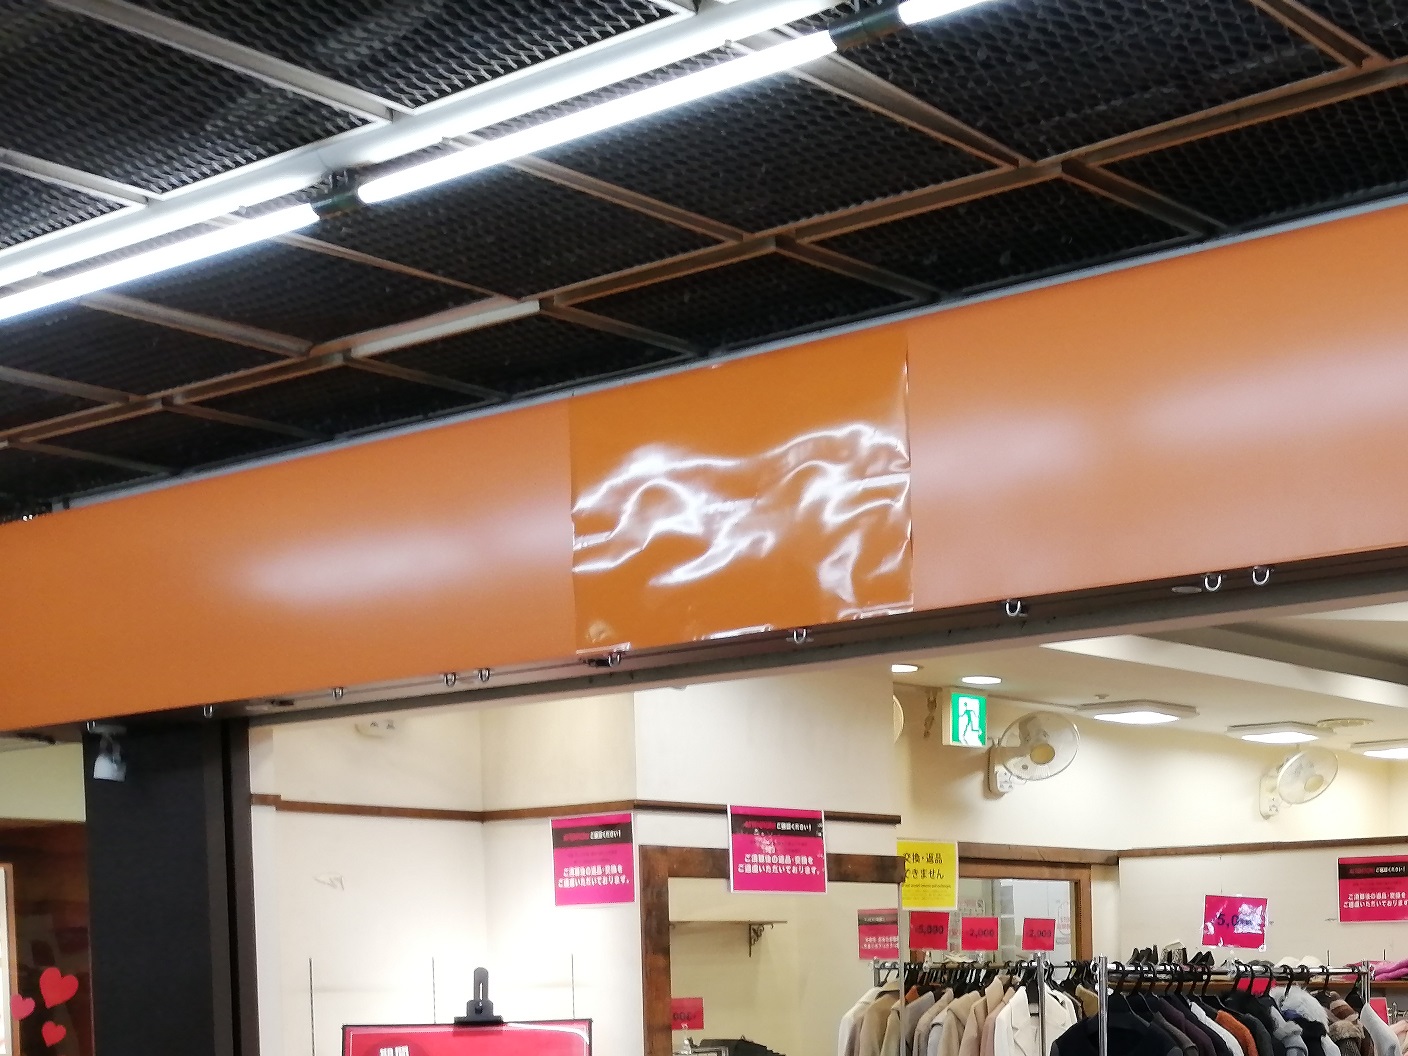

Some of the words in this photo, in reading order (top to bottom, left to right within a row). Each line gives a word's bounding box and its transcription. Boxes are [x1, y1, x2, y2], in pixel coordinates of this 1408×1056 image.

[903, 852, 943, 864] 交換・返品
